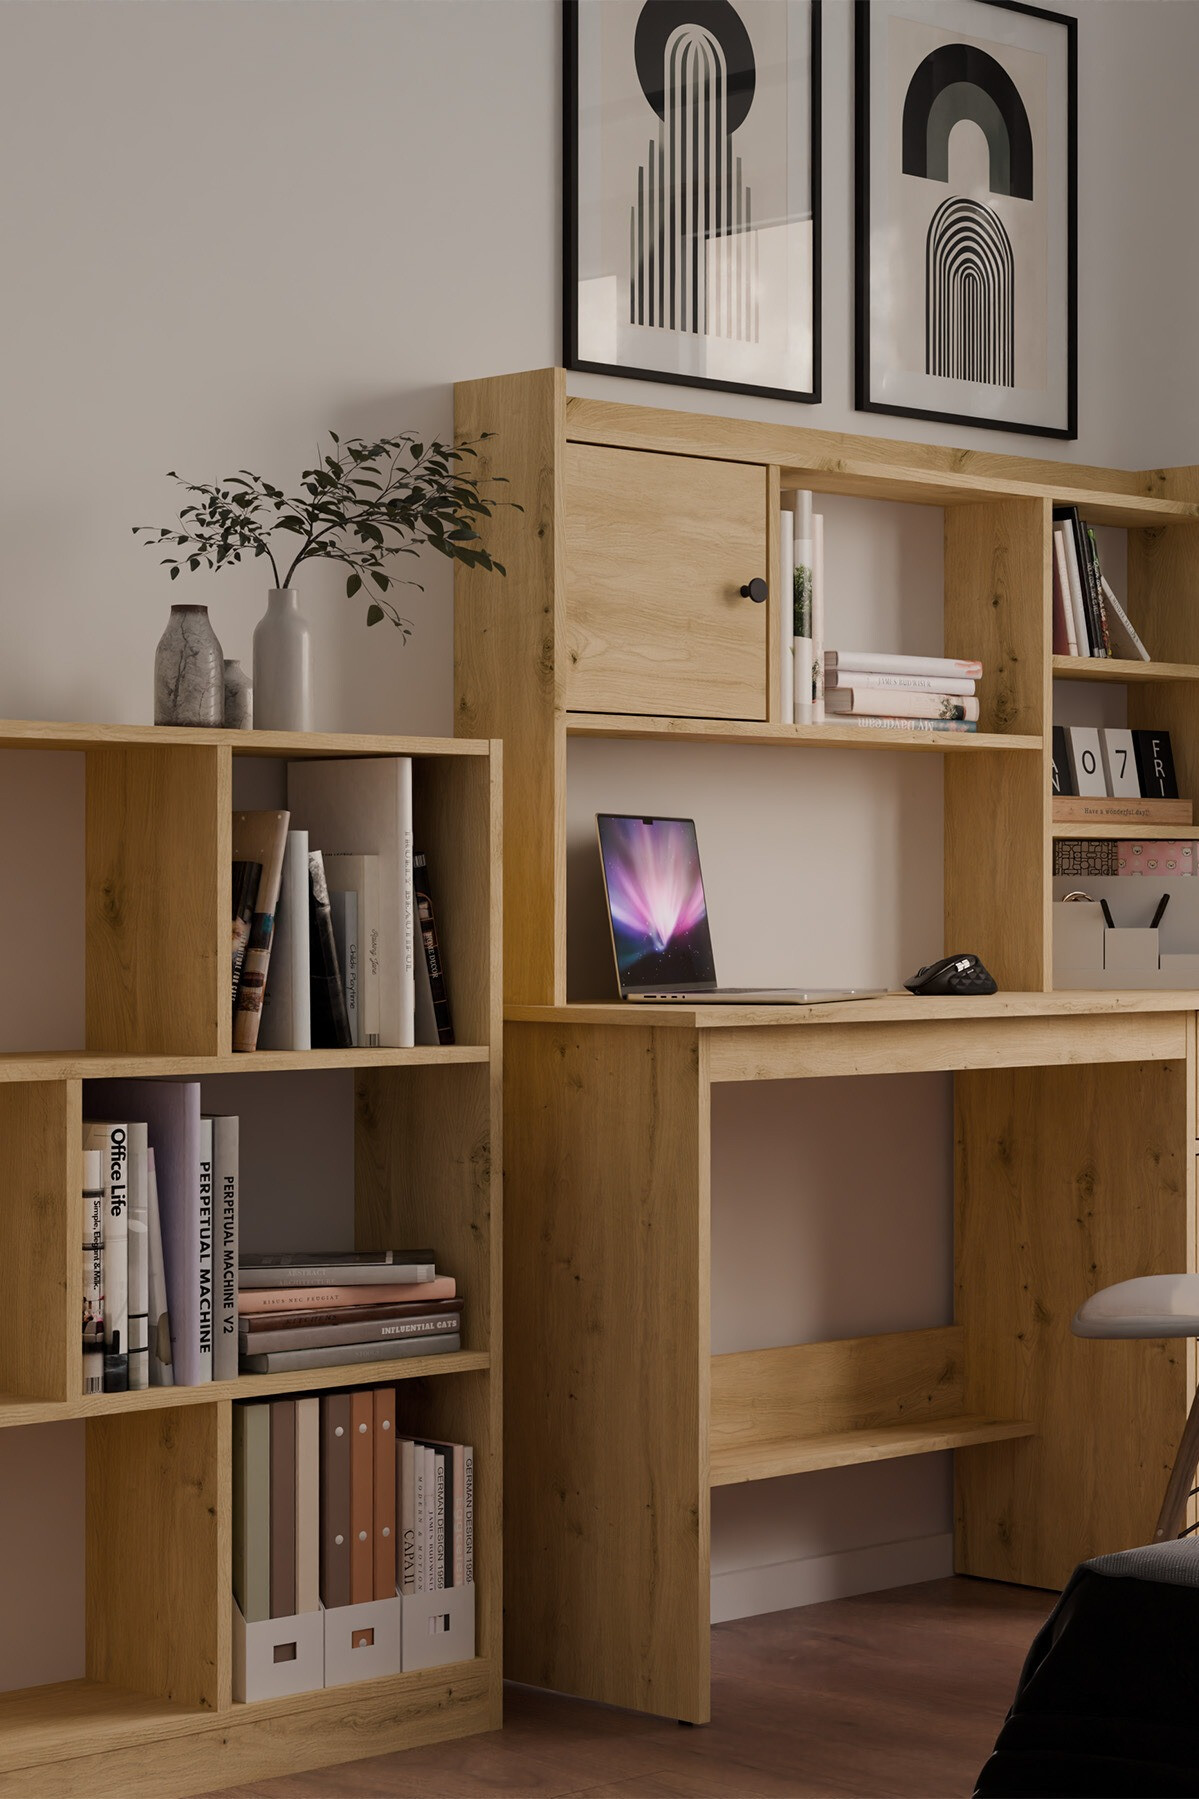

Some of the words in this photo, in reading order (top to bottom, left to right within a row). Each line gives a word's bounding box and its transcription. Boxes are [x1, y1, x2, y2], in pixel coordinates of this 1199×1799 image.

[1152, 740, 1166, 797] FRI
[1105, 808, 1134, 817] wonderful
[232, 970, 241, 984] FOR
[429, 954, 439, 979] DECOR
[346, 972, 357, 1010] Playtime
[110, 1128, 127, 1181] Office
[91, 1200, 101, 1230] Simple,
[110, 1184, 127, 1217] Life
[199, 1161, 211, 1264] PERPETUAL
[223, 1175, 235, 1247] PERPETUAL
[91, 1231, 101, 1261] Elegant
[93, 1262, 100, 1270] &
[93, 1270, 101, 1291] Milk.
[223, 1250, 235, 1309] MACHINE
[287, 1268, 327, 1277] ABSTRACT
[199, 1269, 211, 1353] MACHINE
[223, 1314, 235, 1334] V2
[381, 1322, 435, 1335] INFLUENTIAL
[436, 1319, 457, 1330] CATS
[465, 1458, 473, 1508] GERMAN
[465, 1511, 473, 1554] DESIGN
[404, 1529, 415, 1571] CAPA
[404, 1574, 415, 1585] II
